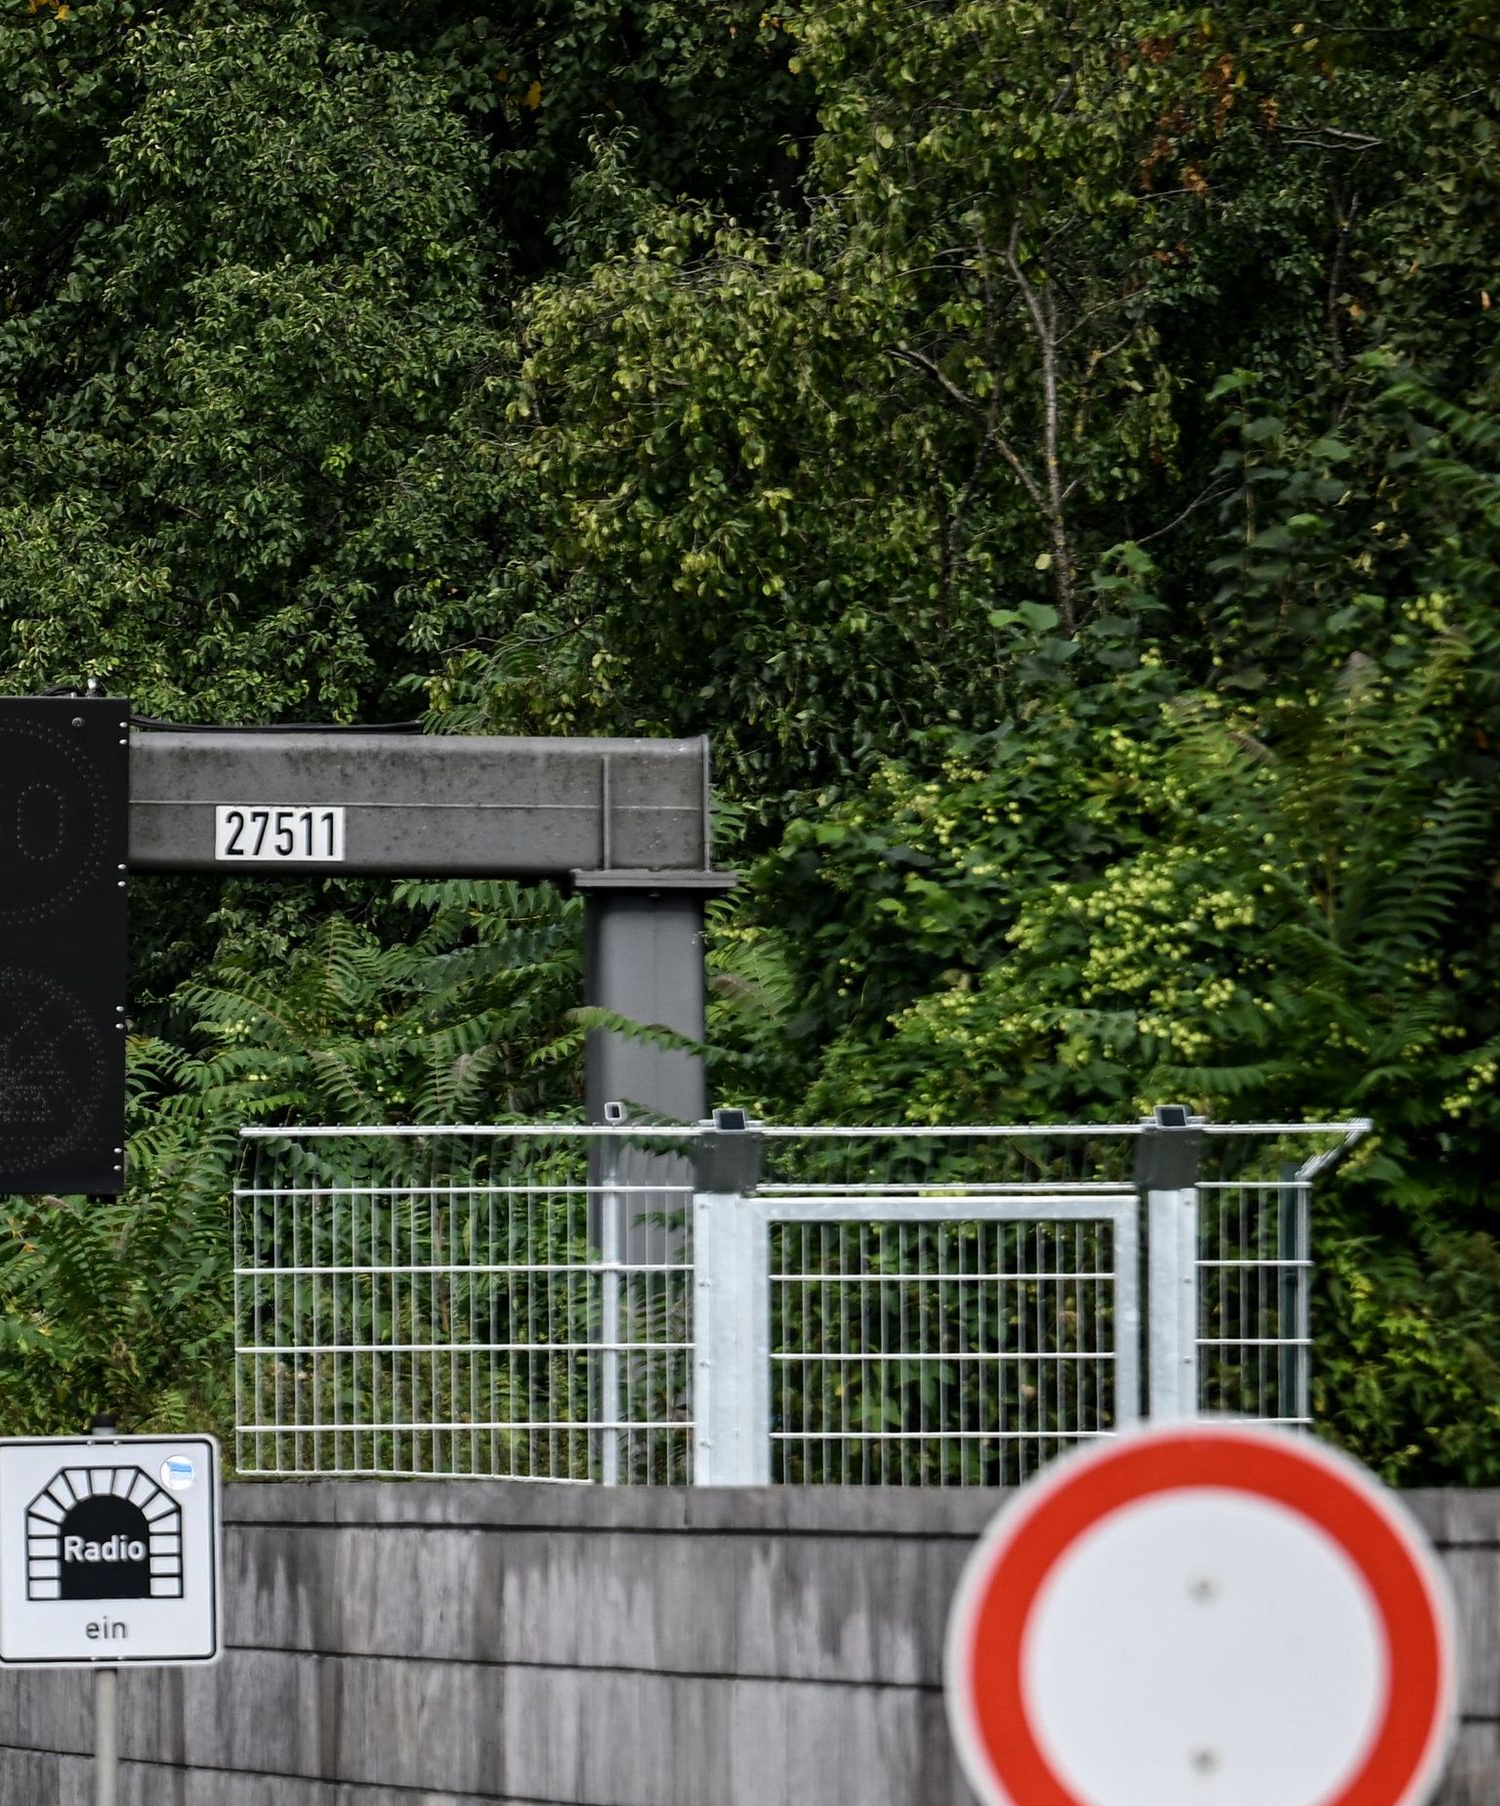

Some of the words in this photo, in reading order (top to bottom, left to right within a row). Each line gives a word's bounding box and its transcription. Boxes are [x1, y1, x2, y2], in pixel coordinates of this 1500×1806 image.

[224, 811, 337, 858] 27511
[63, 1534, 148, 1563] Radio
[85, 1616, 129, 1641] ein
